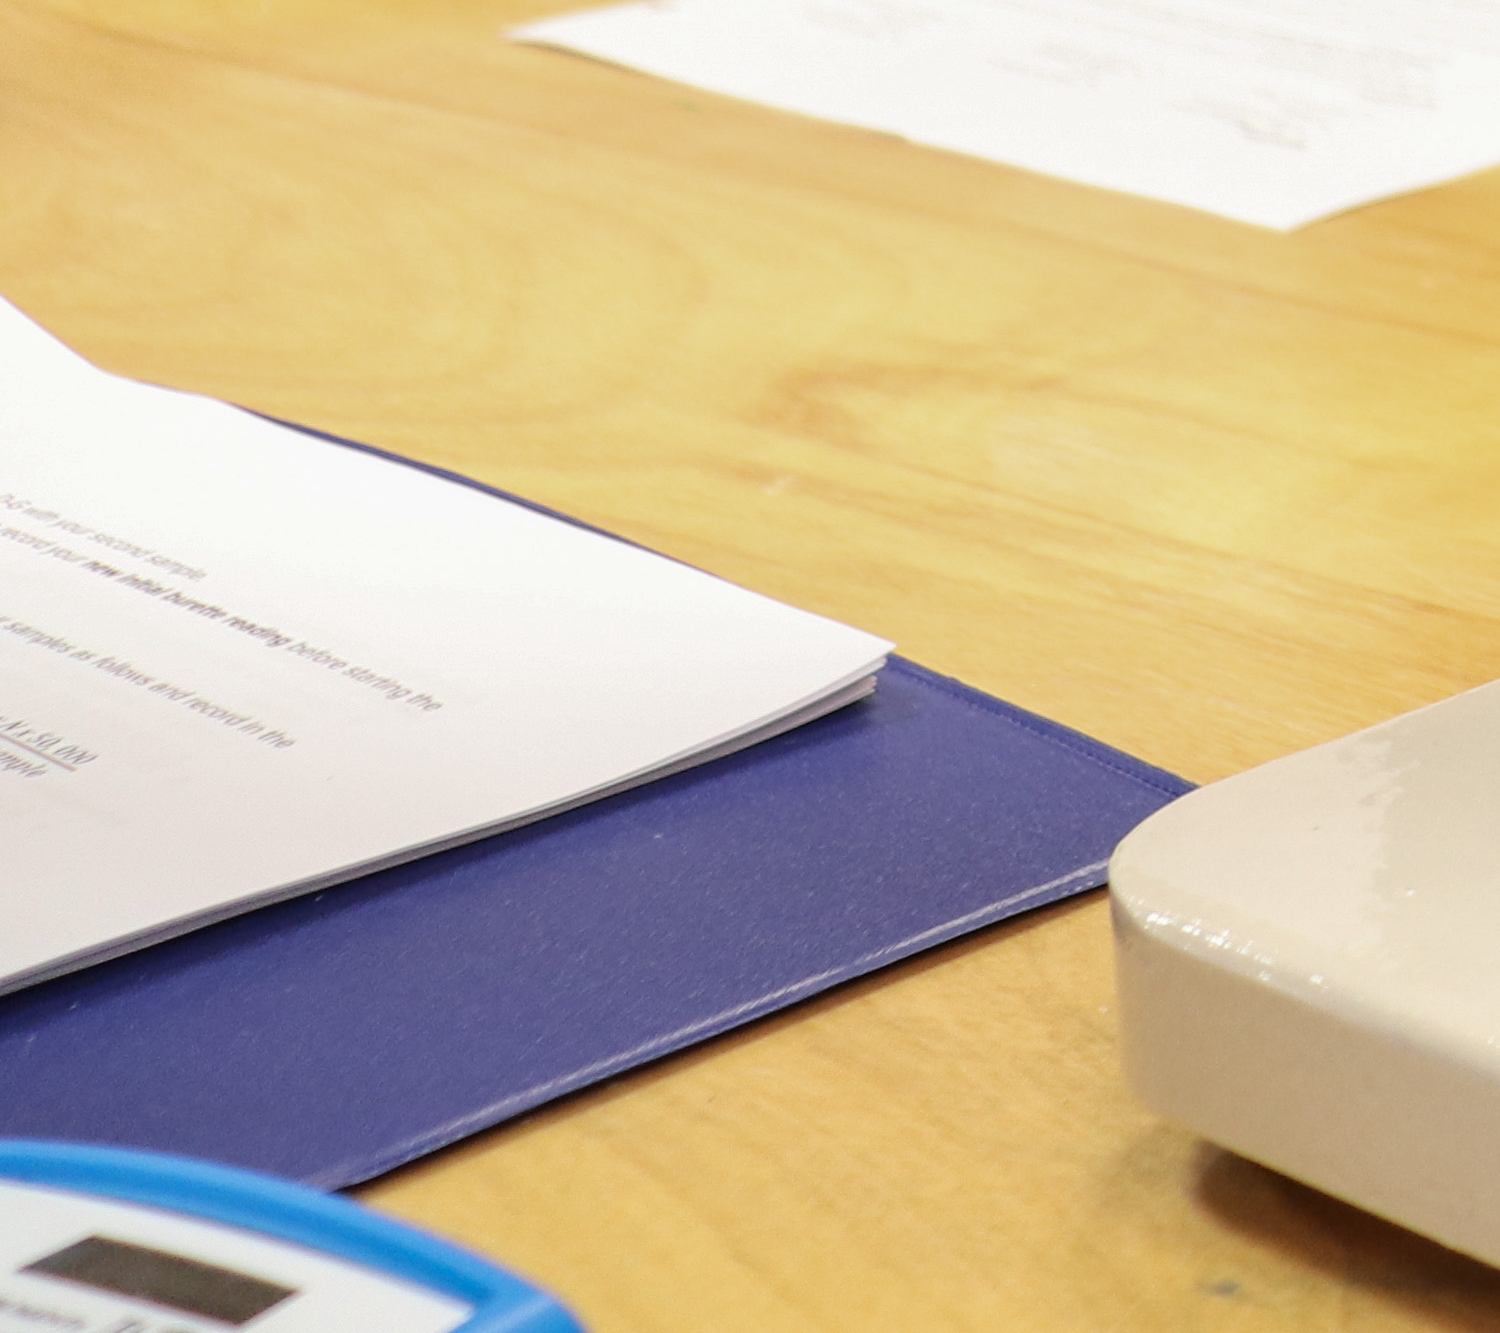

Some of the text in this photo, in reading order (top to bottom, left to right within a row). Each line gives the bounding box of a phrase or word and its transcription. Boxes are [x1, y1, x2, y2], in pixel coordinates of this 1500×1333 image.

[221, 616, 292, 648] reading
[286, 641, 349, 671] before
[341, 665, 414, 701] starting
[405, 692, 444, 713] the
[147, 681, 197, 702] and
[182, 694, 254, 727] record
[237, 720, 265, 736] in
[258, 729, 298, 750] the
